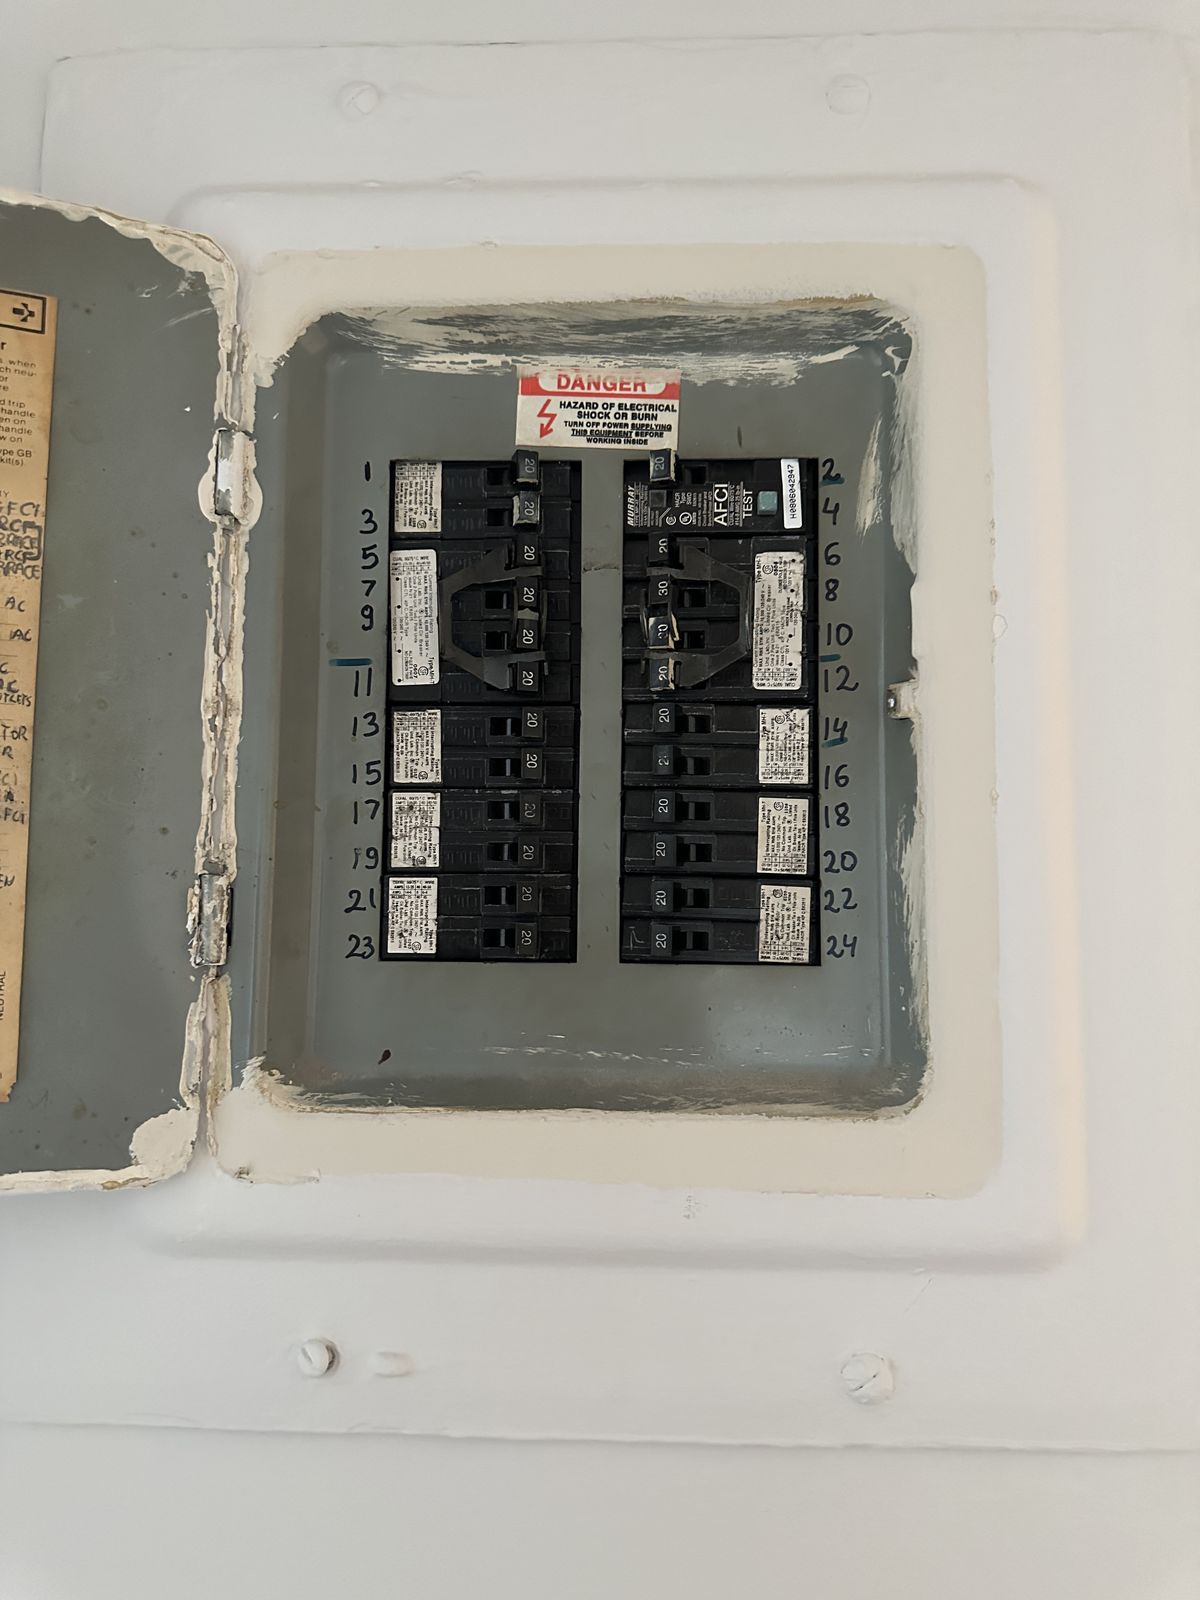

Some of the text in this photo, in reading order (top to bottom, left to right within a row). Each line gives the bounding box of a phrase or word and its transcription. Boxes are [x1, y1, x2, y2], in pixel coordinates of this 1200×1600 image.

[8, 359, 36, 368] when
[556, 374, 647, 392] DANGER
[1, 406, 36, 418] handle
[8, 400, 26, 409] trip
[560, 401, 678, 412] HAZARD OF ELECTRICAL
[577, 411, 658, 422] SHOCK OR BURN
[571, 428, 588, 436] THIS
[590, 430, 633, 438] EQUIPMENT
[630, 423, 672, 432] SUPPLYING
[16, 449, 32, 458] GB
[525, 458, 535, 473] 20
[654, 456, 664, 470] 20
[822, 458, 842, 482] 2
[364, 461, 371, 482] 1
[524, 500, 534, 516] 20
[714, 484, 728, 526] AFCI
[742, 488, 753, 520] TEST
[822, 498, 840, 526] 4
[360, 508, 378, 534] 3
[524, 545, 535, 560] 20
[658, 538, 668, 553] 20
[361, 544, 379, 570] 5
[824, 542, 841, 566] 6
[361, 580, 376, 597] 7
[523, 586, 534, 602] 20
[658, 580, 668, 596] 30
[825, 578, 840, 602] 8
[5, 596, 26, 612] AC
[360, 604, 374, 631] 9
[522, 629, 534, 644] 20
[826, 622, 854, 646] 10
[522, 670, 534, 686] 20
[658, 665, 668, 681] 20
[824, 664, 859, 693] 12
[354, 668, 372, 697] 11
[526, 712, 538, 728] 20
[658, 708, 670, 723] 20
[352, 712, 380, 738] 13
[824, 716, 848, 741] 14
[526, 754, 538, 769] 20
[352, 760, 381, 785] 15
[824, 764, 850, 790] 16
[353, 799, 380, 824] 17
[524, 802, 536, 818] 20
[658, 798, 668, 813] 20
[824, 802, 850, 828] 18
[522, 845, 534, 860] 20
[656, 842, 666, 857] 20
[352, 846, 380, 870] 19
[823, 850, 858, 873] 20
[344, 888, 376, 914] 21
[522, 886, 532, 902] 20
[655, 890, 667, 906] 20
[824, 888, 858, 913] 22
[521, 930, 532, 946] 20
[656, 933, 667, 948] 20
[345, 934, 376, 959] 23
[826, 935, 858, 958] 24
